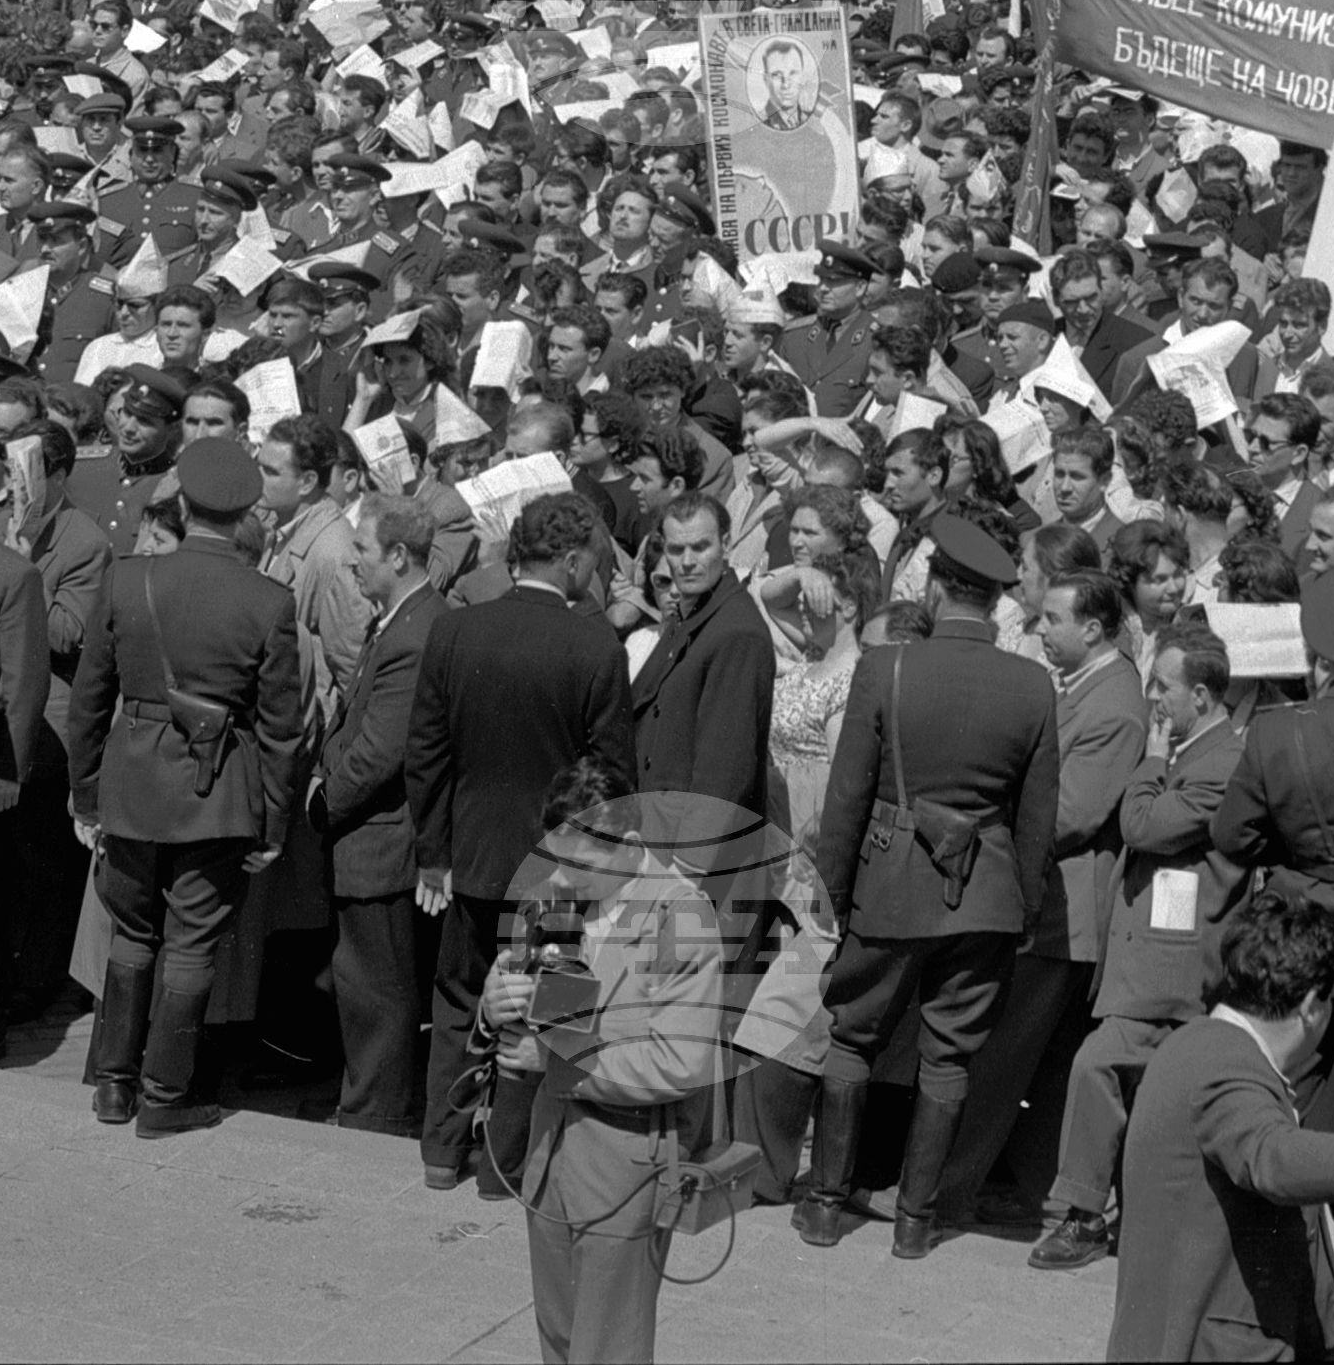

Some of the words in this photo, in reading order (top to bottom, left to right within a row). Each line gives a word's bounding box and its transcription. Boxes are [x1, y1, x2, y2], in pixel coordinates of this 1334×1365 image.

[821, 38, 838, 51] НА
[1113, 26, 1224, 88] БЪДЕЩЕ
[1232, 57, 1267, 99] НА
[714, 135, 735, 188] ПЪРВИЯ
[719, 192, 736, 215] НА
[744, 211, 850, 257] СССР!
